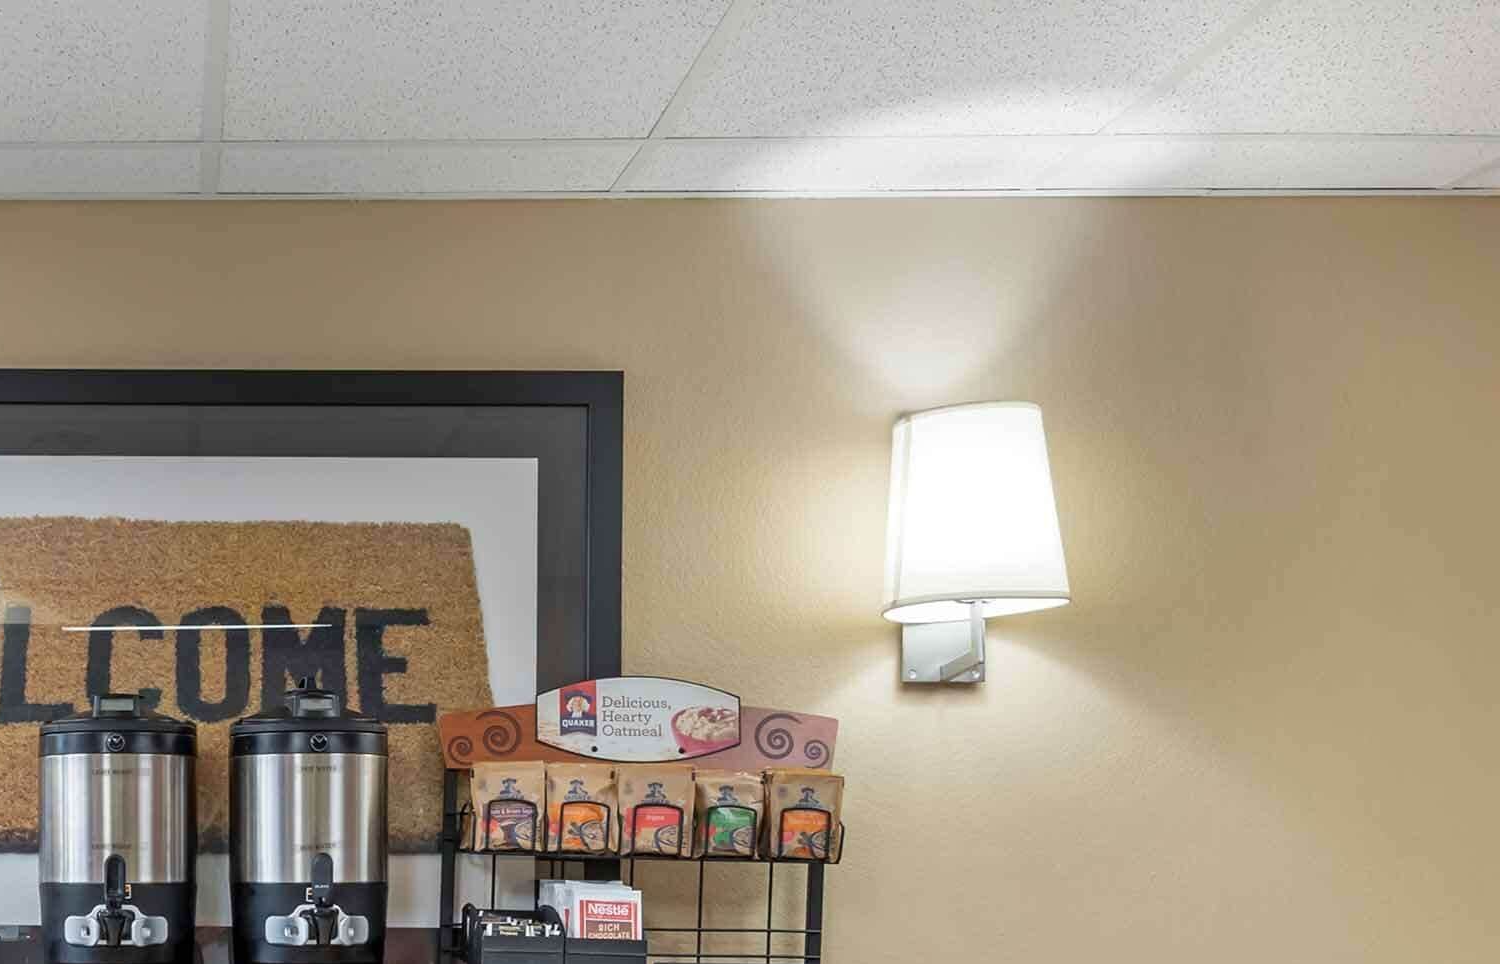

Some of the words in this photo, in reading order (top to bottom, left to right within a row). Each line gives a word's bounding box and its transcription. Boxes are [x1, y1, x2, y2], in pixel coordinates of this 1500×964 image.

[602, 695, 672, 710] Delicious,
[562, 718, 596, 728] QUAKER
[602, 711, 652, 725] Hearty
[602, 725, 662, 737] Oatmeal
[587, 903, 629, 916] Nestlé
[598, 923, 620, 931] RICH
